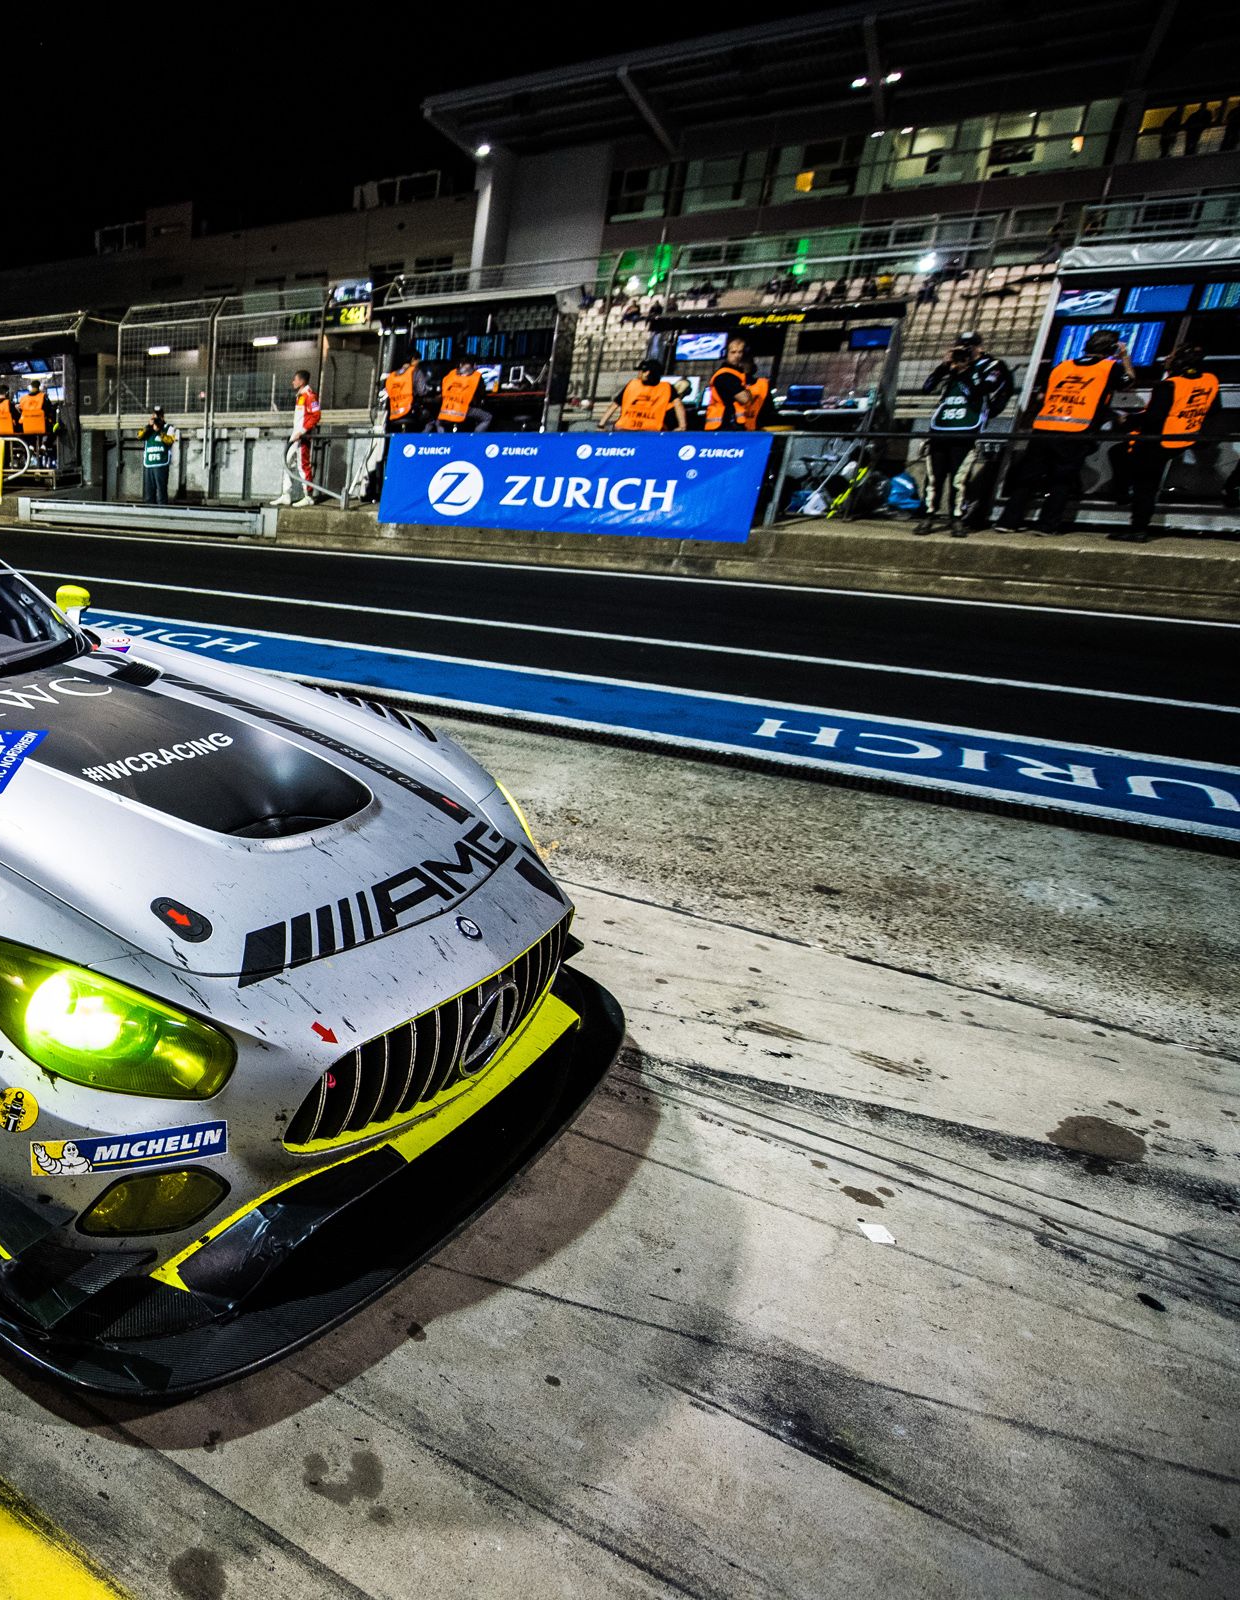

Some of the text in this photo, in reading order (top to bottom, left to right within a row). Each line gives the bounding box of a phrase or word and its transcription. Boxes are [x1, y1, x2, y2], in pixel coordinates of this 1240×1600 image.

[417, 446, 451, 455] ZURICH
[502, 447, 538, 456] ZURICH
[594, 447, 635, 457] ZURICH
[699, 449, 745, 459] ZURICH
[499, 475, 678, 513] ZURICH
[3, 731, 39, 769] NORDRHEIN
[82, 731, 235, 782] #IWCRACING
[366, 819, 517, 934] AMG
[93, 1127, 224, 1162] MICHELIN
